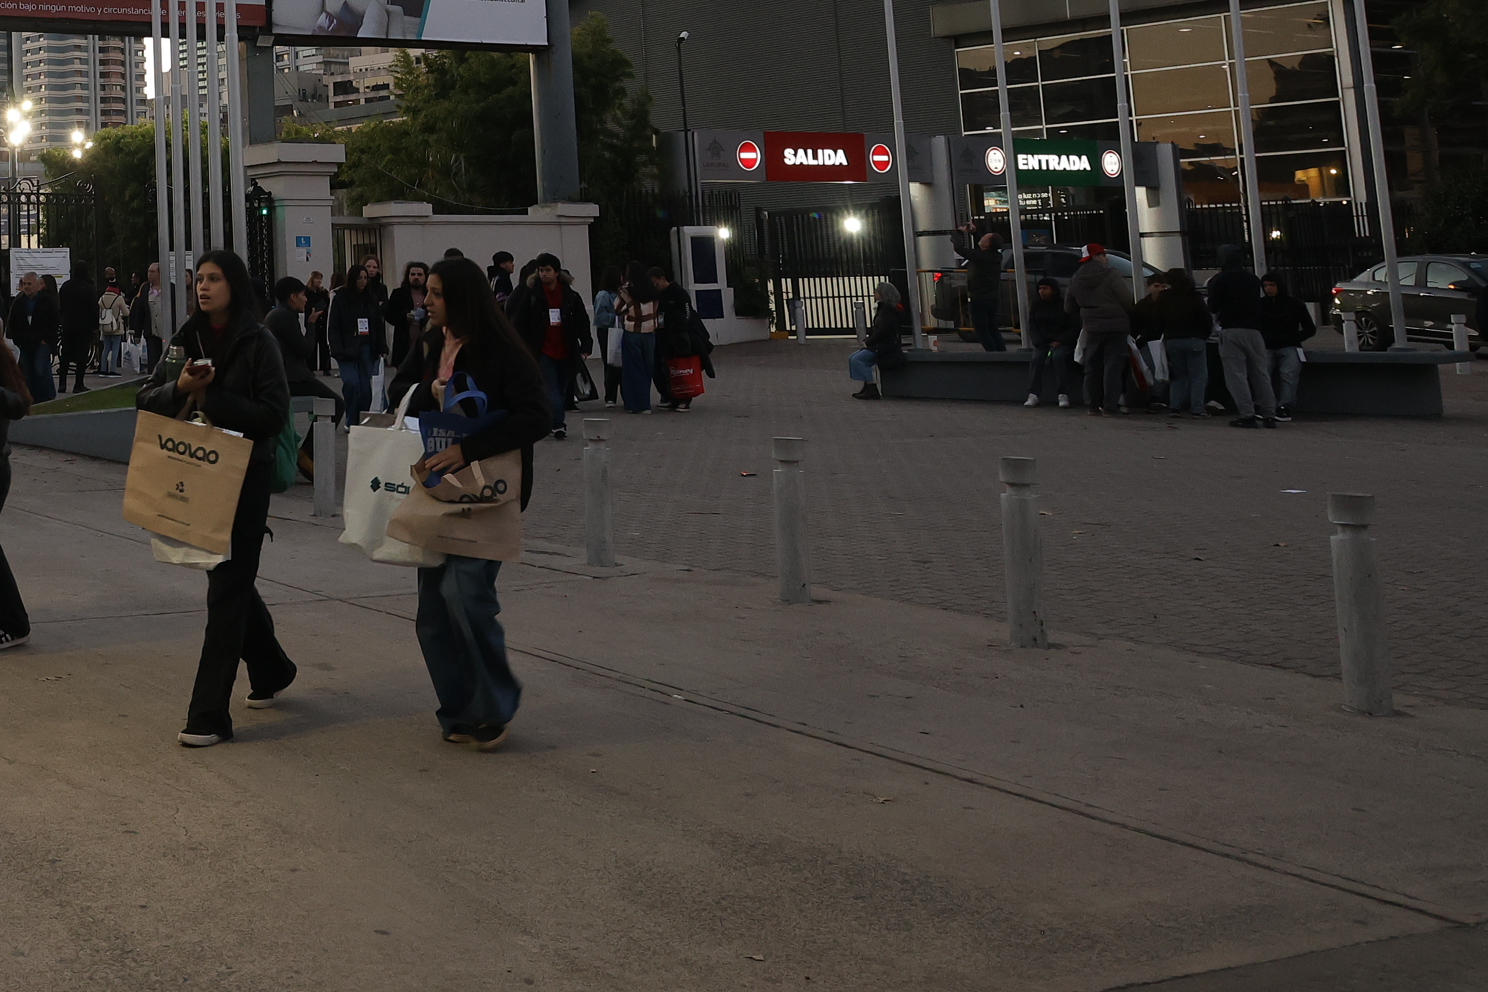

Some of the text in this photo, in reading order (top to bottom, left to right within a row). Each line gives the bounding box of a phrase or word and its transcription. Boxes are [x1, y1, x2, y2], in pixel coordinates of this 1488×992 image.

[19, 0, 36, 13] bajo
[38, 2, 66, 14] ningún
[68, 3, 95, 13] motivo
[97, 6, 102, 15] y
[783, 148, 848, 166] SALIDA
[1017, 154, 1091, 172] ENTRADA
